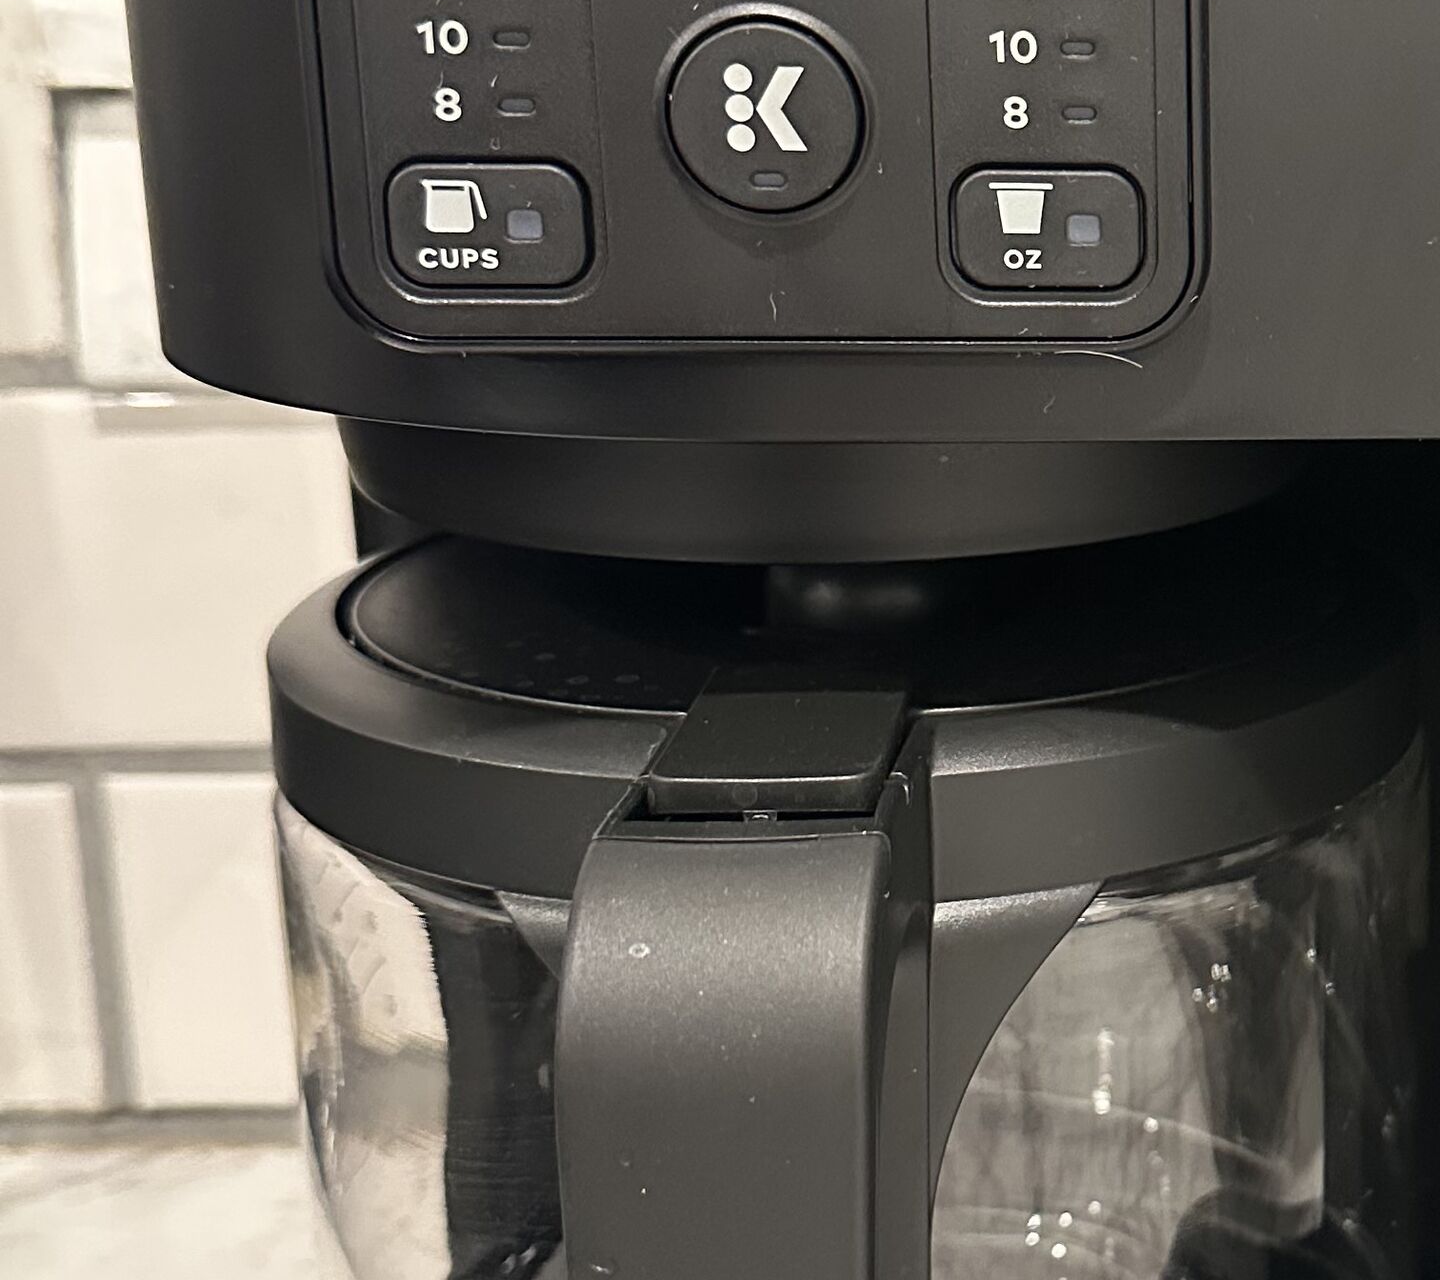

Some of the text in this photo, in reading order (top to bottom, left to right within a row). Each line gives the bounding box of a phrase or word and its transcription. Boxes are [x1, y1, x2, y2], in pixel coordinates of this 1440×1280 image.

[416, 19, 469, 55] 10
[988, 29, 1038, 64] 10
[434, 87, 462, 122] 8
[1002, 95, 1030, 130] 8
[418, 247, 500, 270] CUPS
[1003, 248, 1043, 270] OZ
